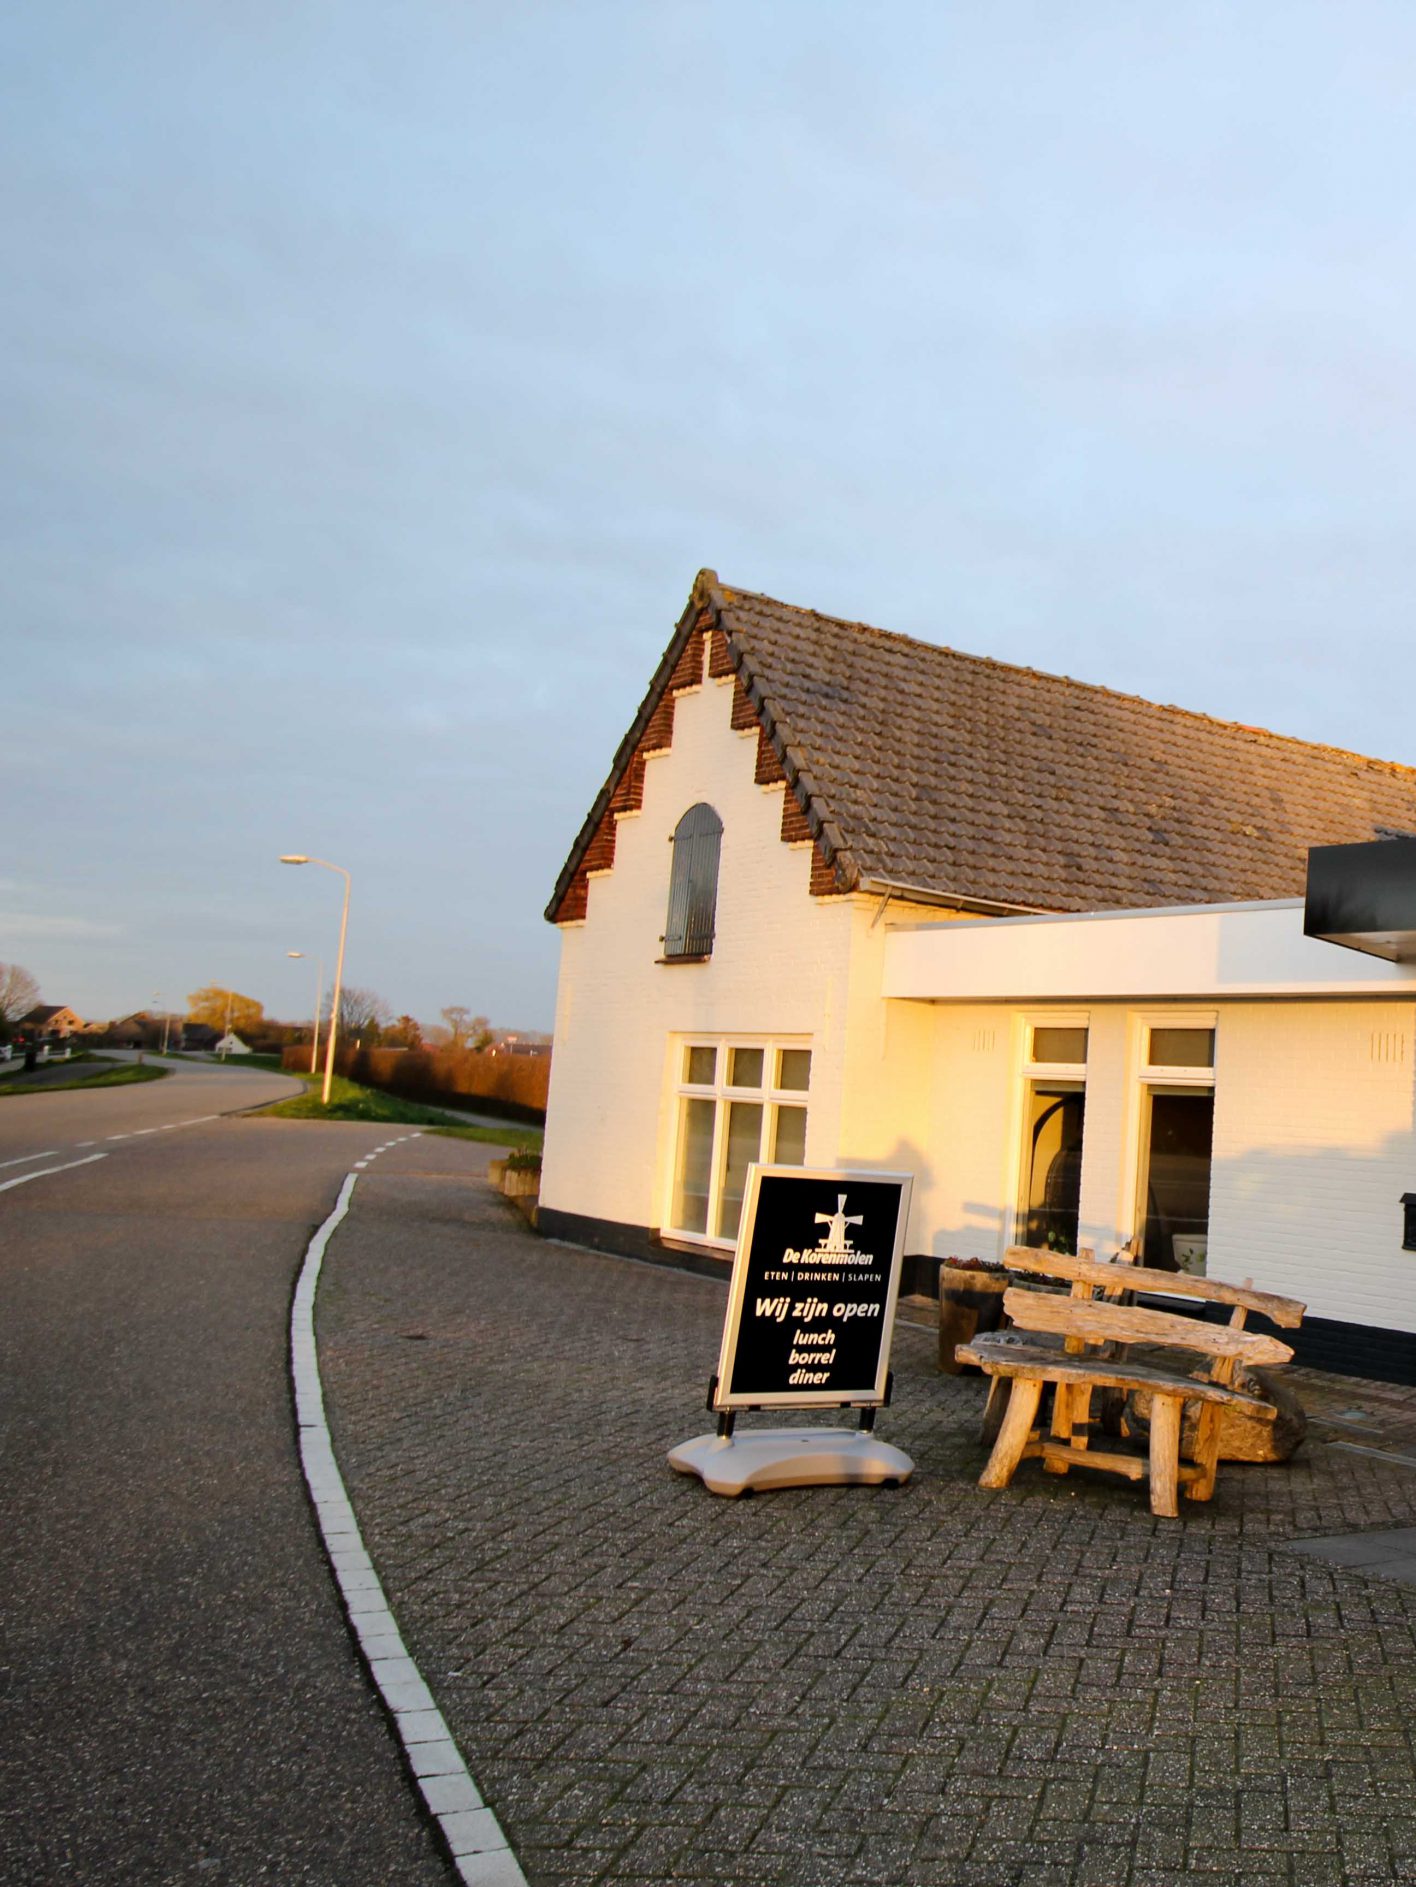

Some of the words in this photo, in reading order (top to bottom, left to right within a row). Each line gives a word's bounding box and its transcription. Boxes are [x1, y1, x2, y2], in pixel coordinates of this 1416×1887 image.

[782, 1248, 800, 1264] De
[800, 1248, 873, 1265] Korenmolen
[764, 1271, 788, 1281] ETEN
[797, 1272, 840, 1281] DRINKEN
[847, 1273, 882, 1282] SLAPEN
[755, 1297, 791, 1322] Wij
[792, 1297, 829, 1322] zijn
[832, 1302, 880, 1322] open
[792, 1328, 835, 1344] lunch
[788, 1348, 836, 1364] borrel
[788, 1368, 830, 1384] diner
